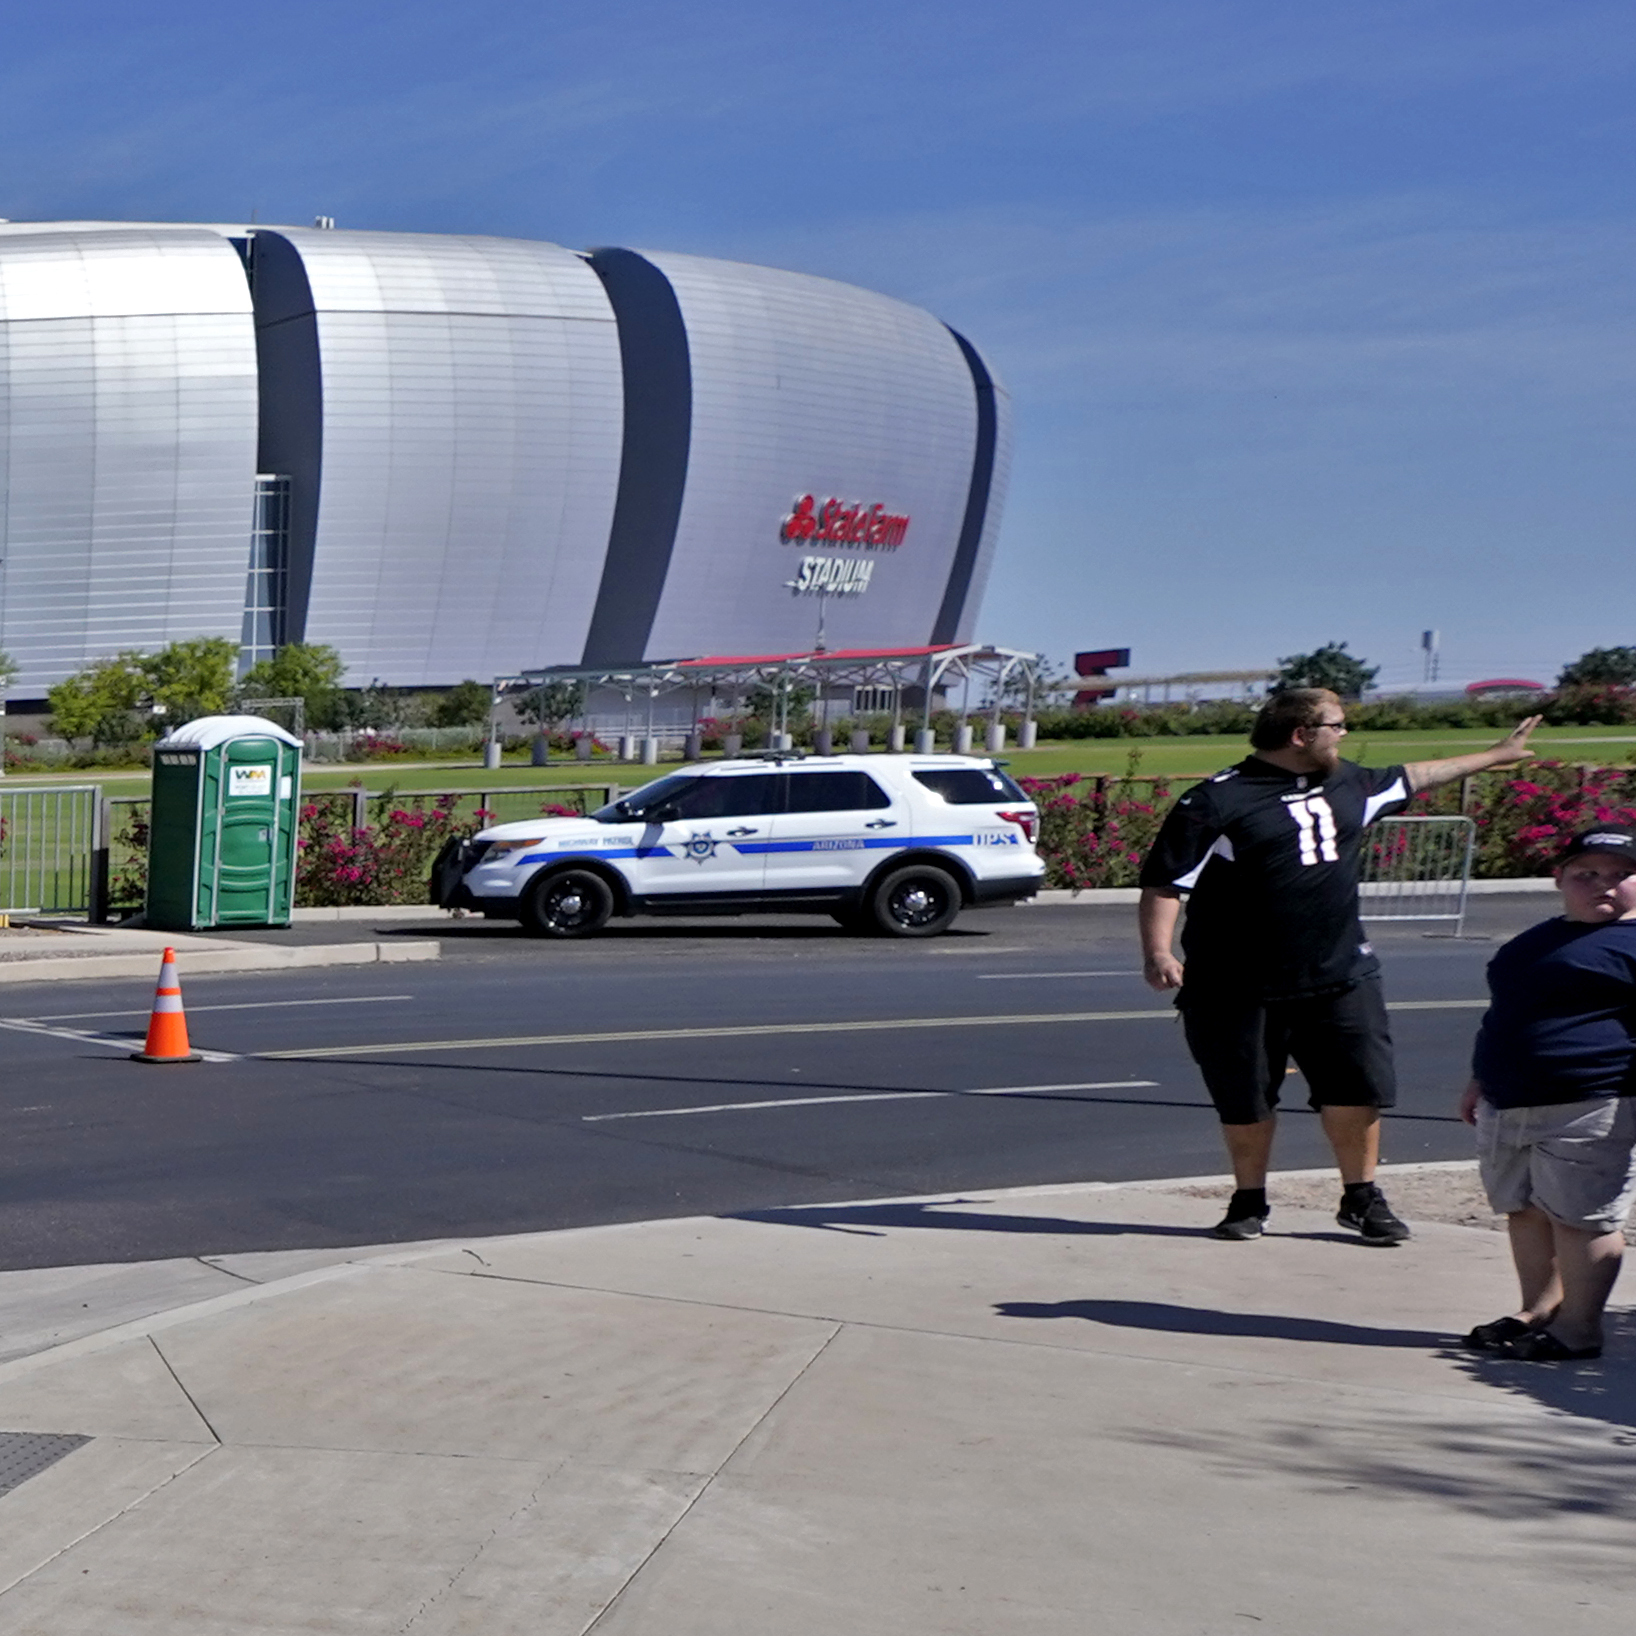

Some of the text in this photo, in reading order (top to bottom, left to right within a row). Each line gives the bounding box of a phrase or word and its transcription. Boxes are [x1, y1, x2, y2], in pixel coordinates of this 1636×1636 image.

[816, 497, 910, 547] State Farm
[798, 556, 874, 594] STADIUM
[812, 839, 866, 851] ARIZONA
[972, 833, 1013, 846] DPS
[1287, 796, 1339, 866] 11
